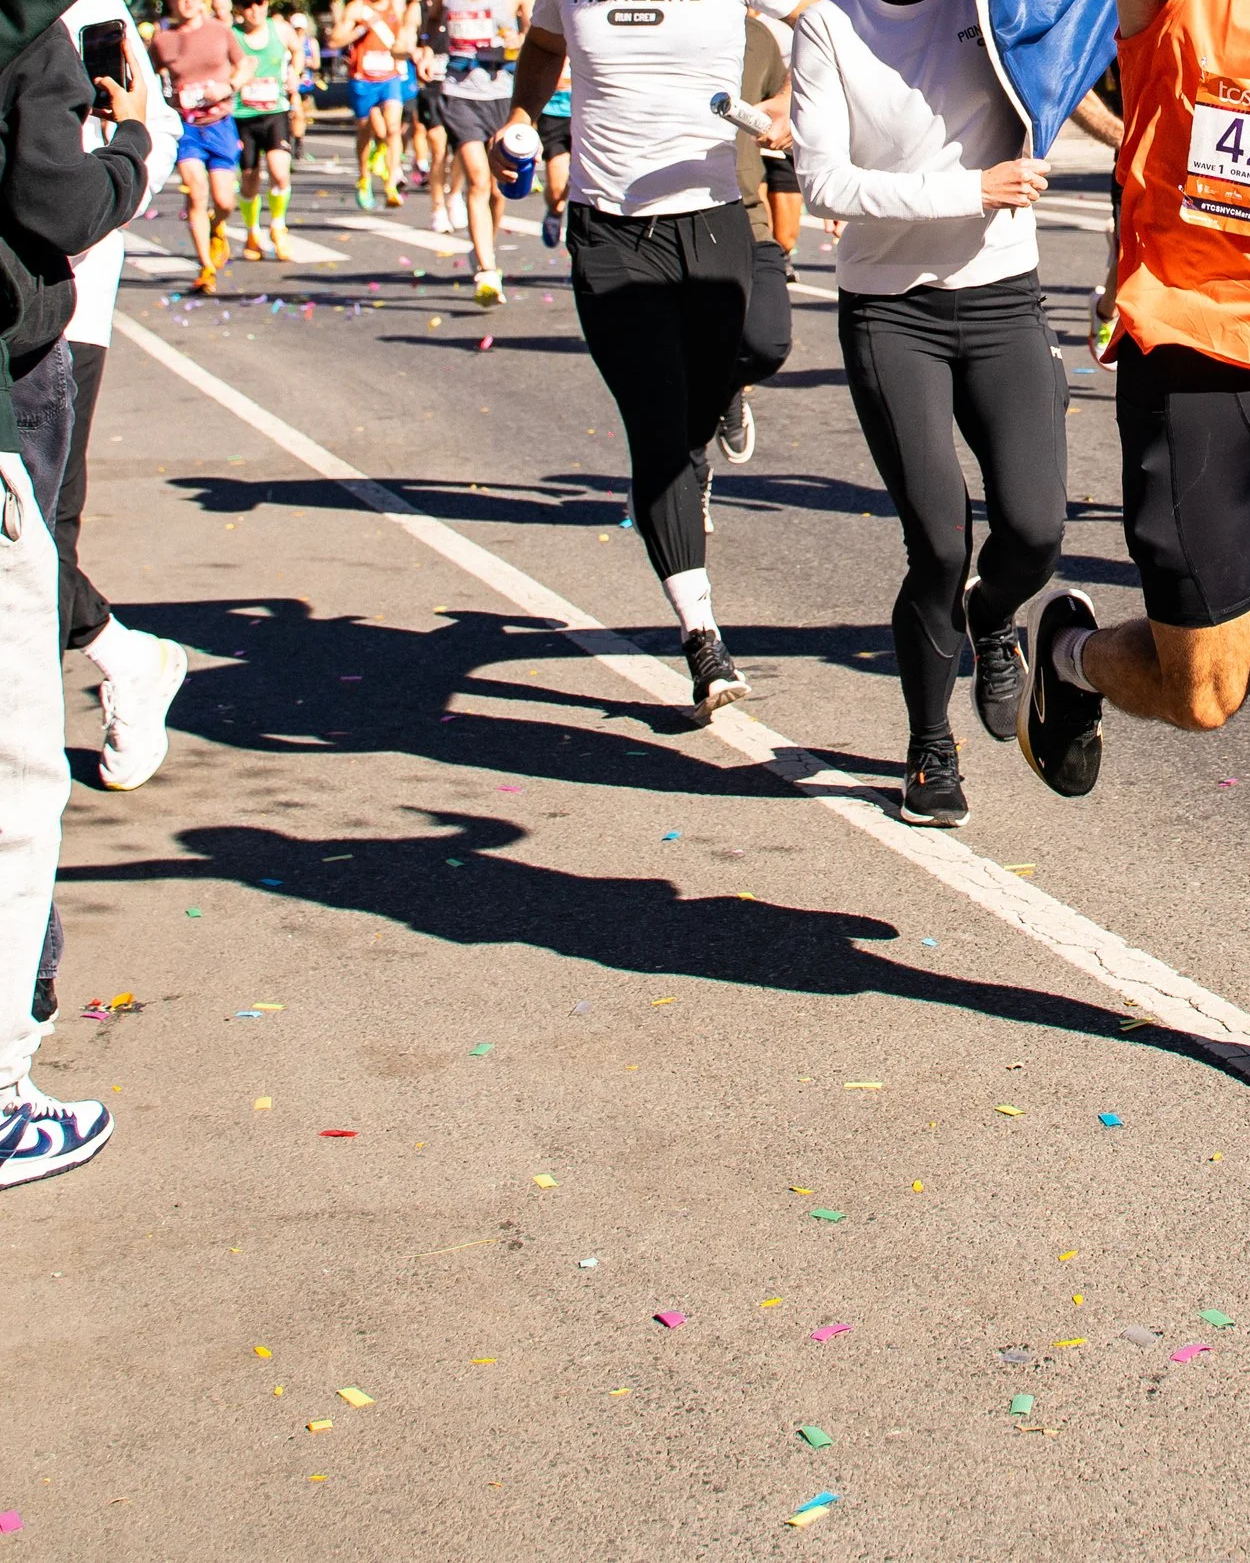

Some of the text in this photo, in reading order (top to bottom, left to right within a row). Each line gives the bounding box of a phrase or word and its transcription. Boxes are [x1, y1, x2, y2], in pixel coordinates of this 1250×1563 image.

[614, 12, 657, 22] RUN CREW
[1193, 161, 1216, 172] WAVE
[1218, 164, 1224, 175] 1
